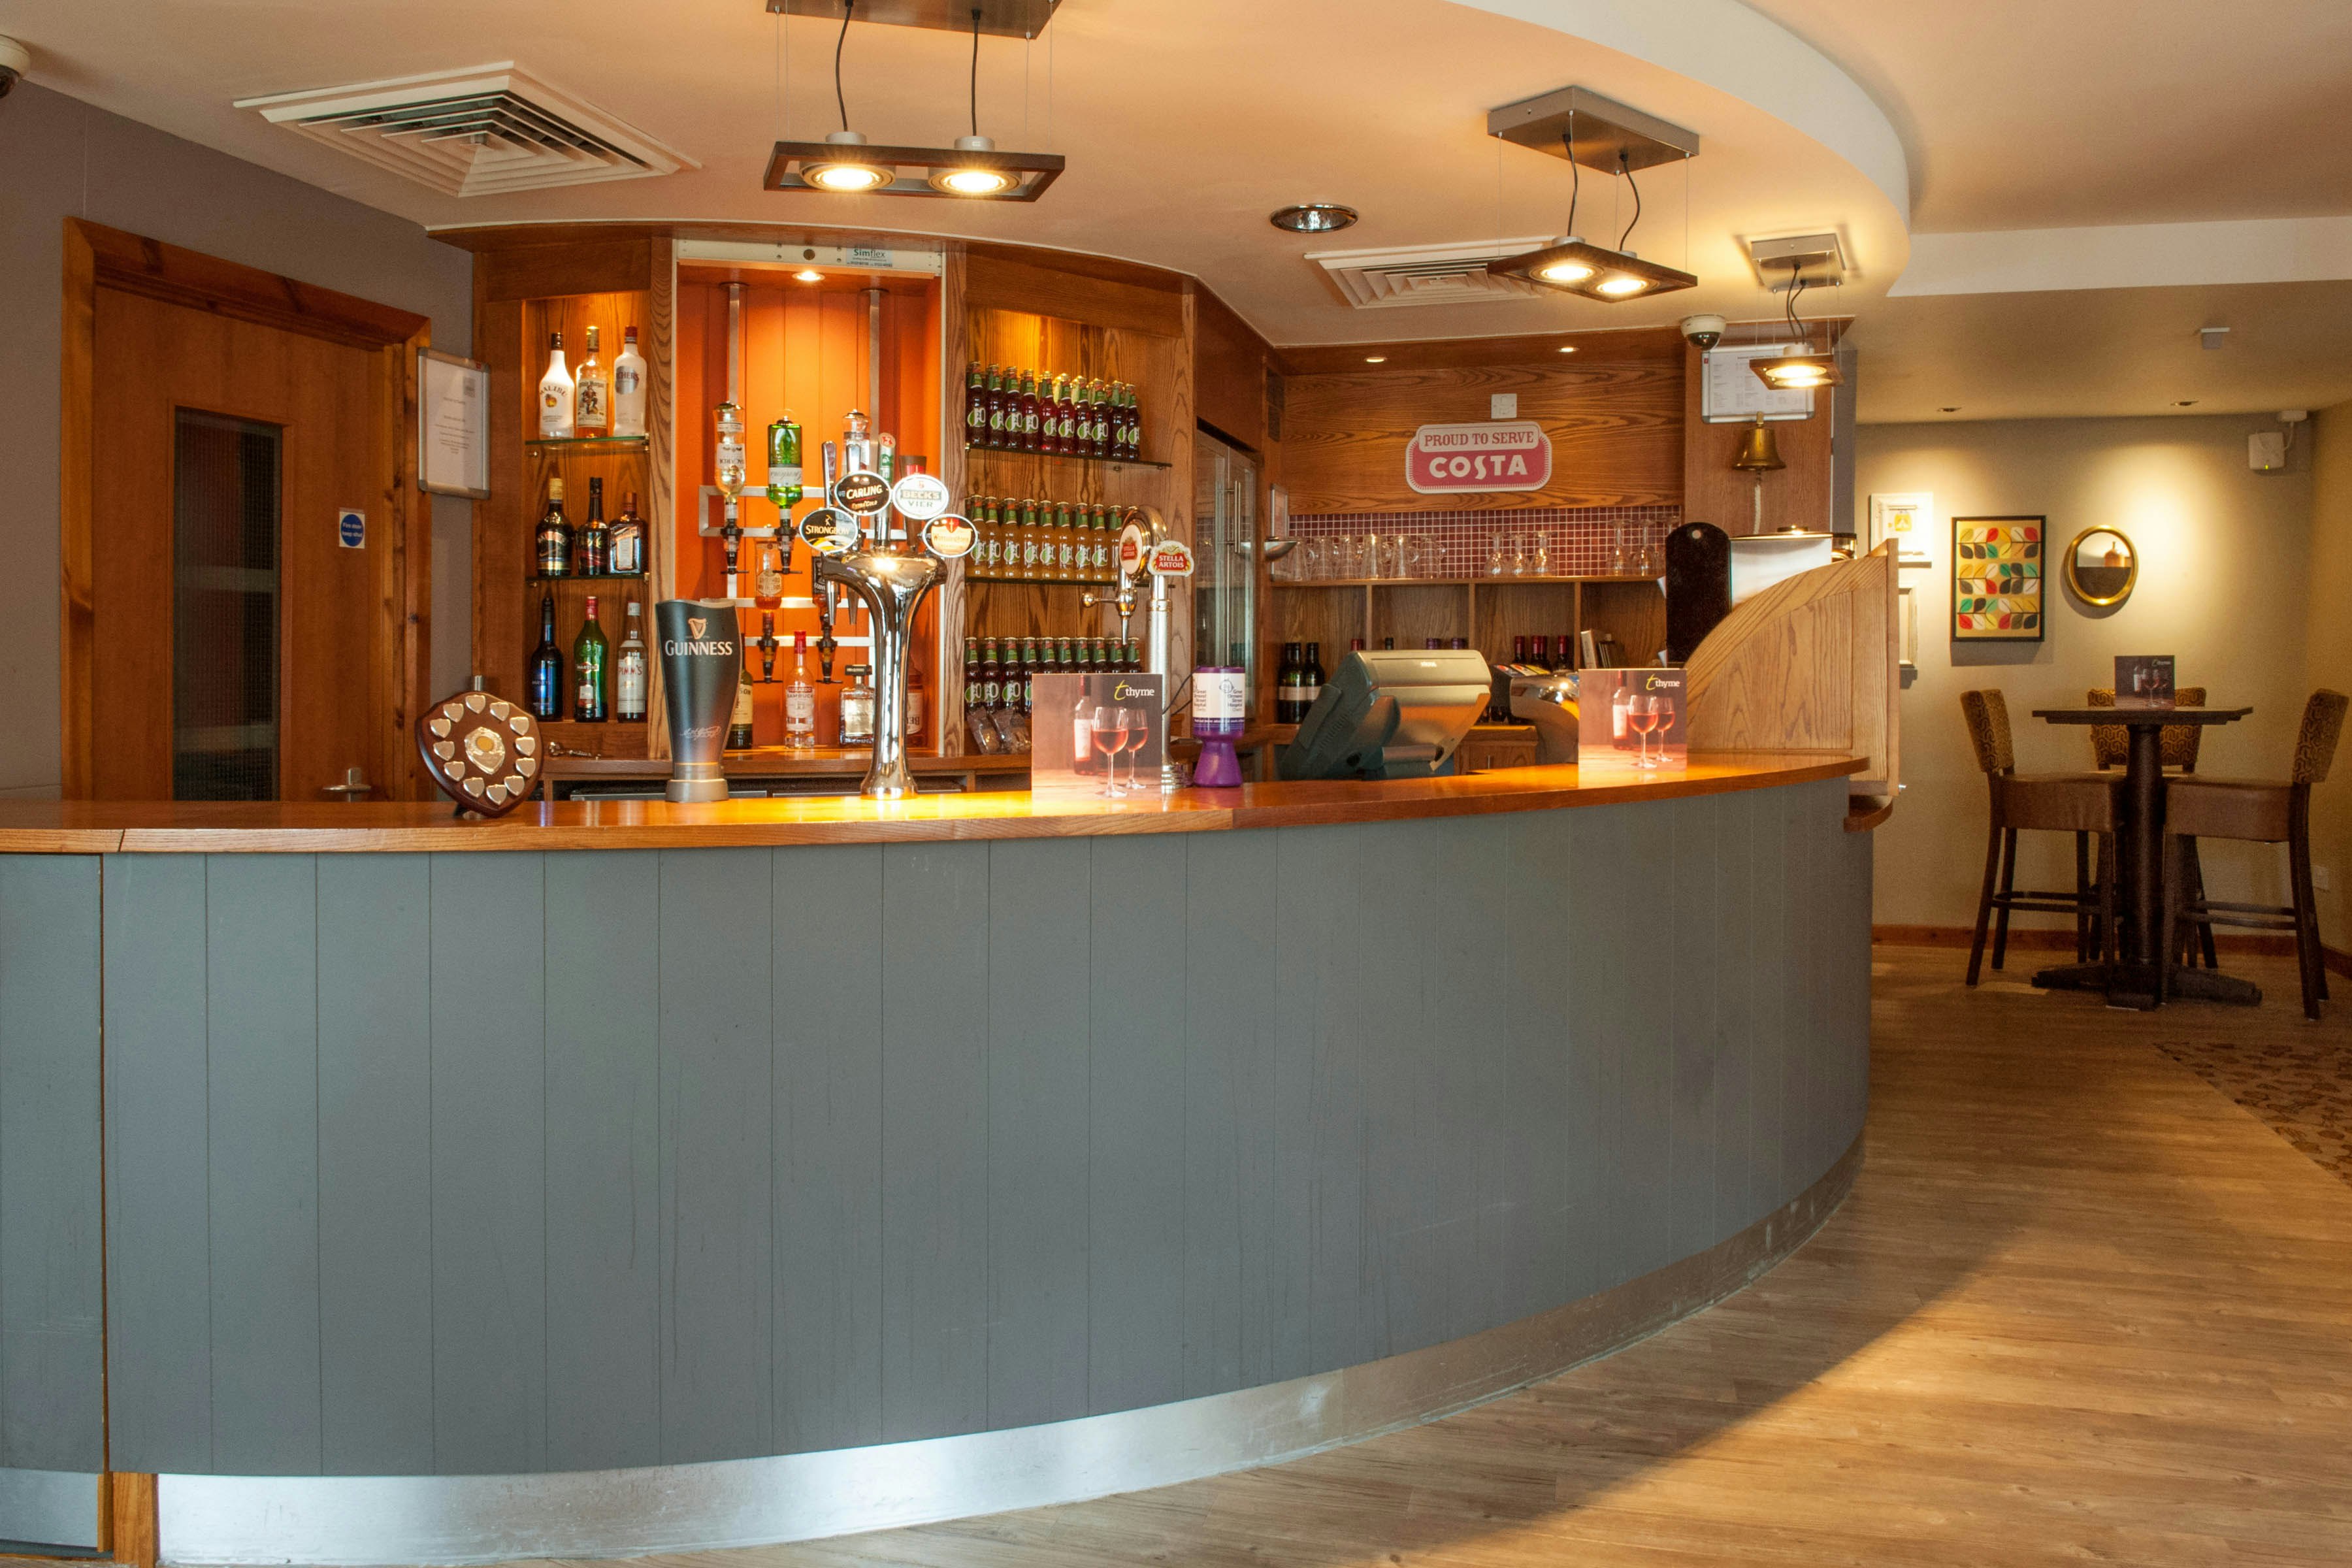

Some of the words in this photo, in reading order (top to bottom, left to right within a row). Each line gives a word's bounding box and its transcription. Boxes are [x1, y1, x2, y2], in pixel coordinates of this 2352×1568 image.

[540, 385, 568, 397] MALIBU
[1424, 433, 1469, 448] PROUD
[1471, 433, 1489, 446] TO
[1492, 431, 1535, 445] SERVE
[1429, 455, 1528, 480] COSTA
[846, 485, 883, 500] CARLING
[805, 525, 850, 535] STRONGBOW
[665, 639, 733, 656] GUINNESS
[617, 664, 643, 676] PIMM'S
[1655, 679, 1680, 689] thyme
[1126, 687, 1155, 697] thyme
